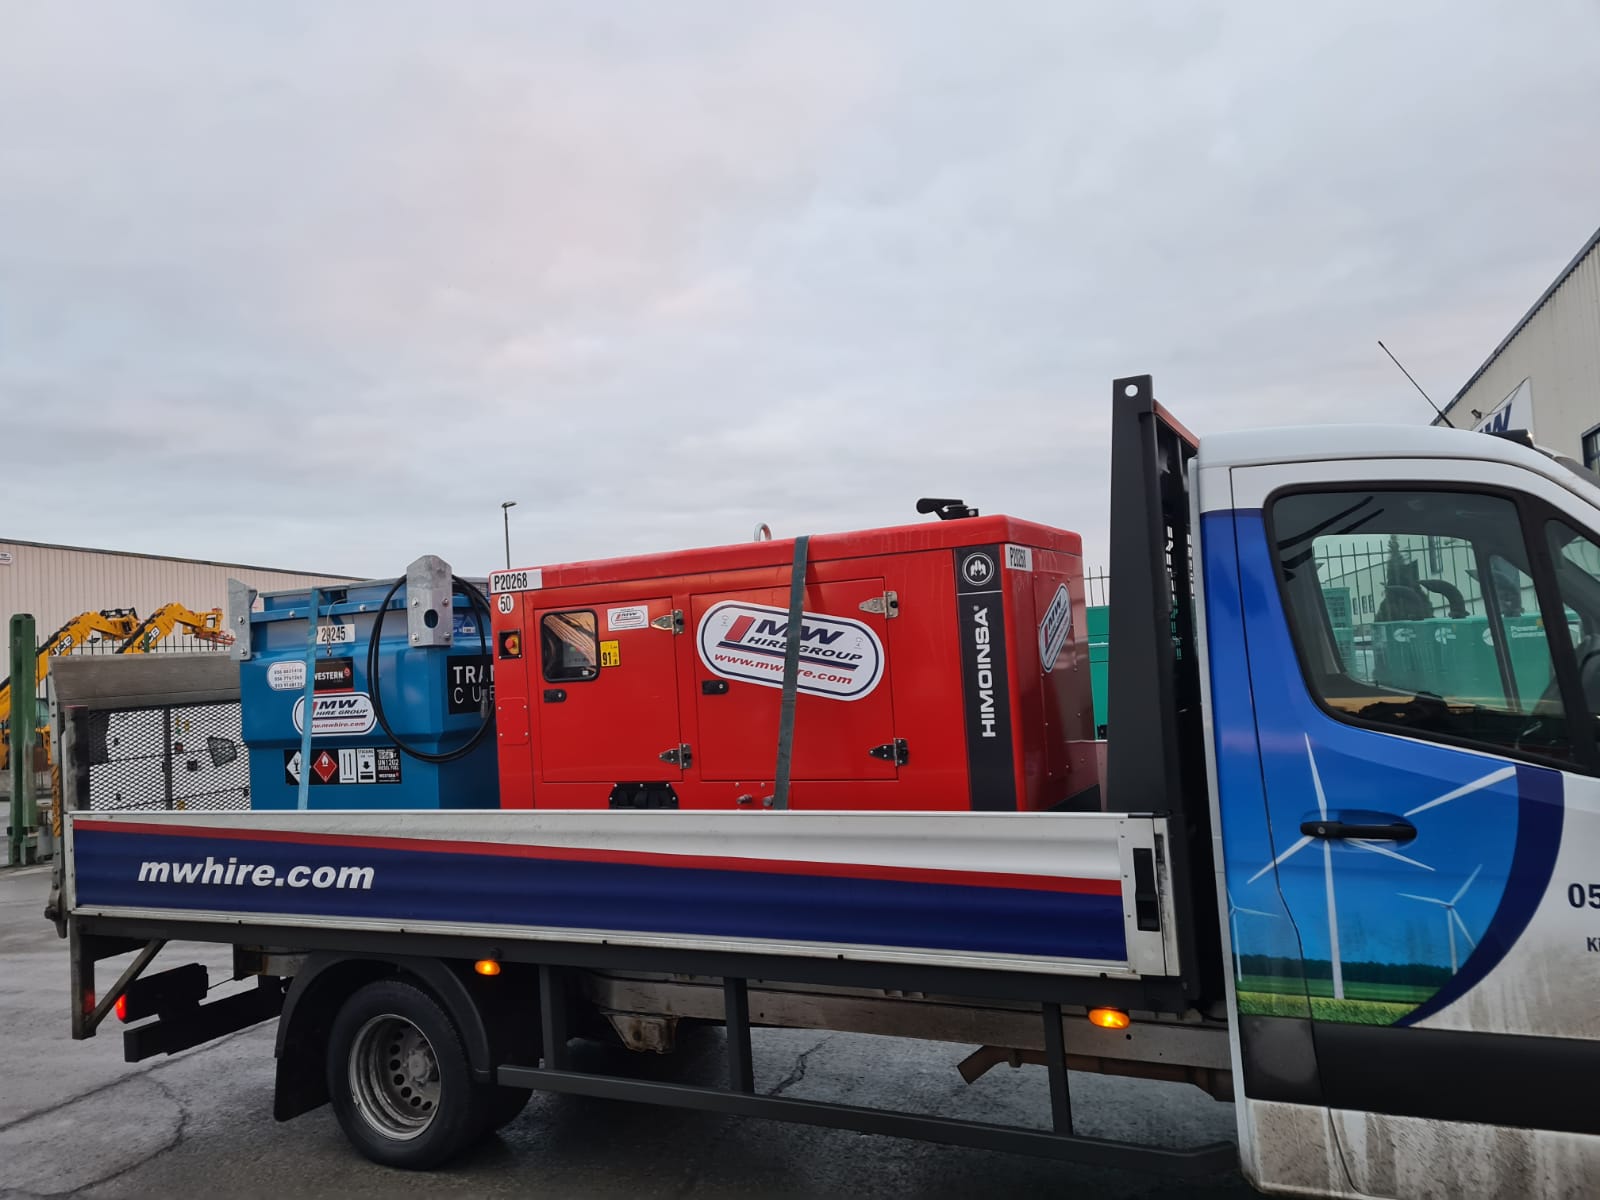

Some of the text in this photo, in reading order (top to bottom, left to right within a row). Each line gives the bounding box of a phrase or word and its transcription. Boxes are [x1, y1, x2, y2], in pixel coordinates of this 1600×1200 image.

[494, 572, 528, 591] P20268
[500, 595, 512, 612] 50
[316, 626, 346, 642] 29245
[755, 620, 844, 645] MW
[602, 651, 612, 666] 91
[747, 636, 863, 662] HIRE GROUP
[714, 653, 853, 686] www.mwre.com
[974, 607, 996, 737] HIMOINSA
[318, 699, 359, 710] MW
[137, 856, 376, 890] mwhire.com
[1567, 882, 1600, 909] 05
[1586, 936, 1600, 953] K
